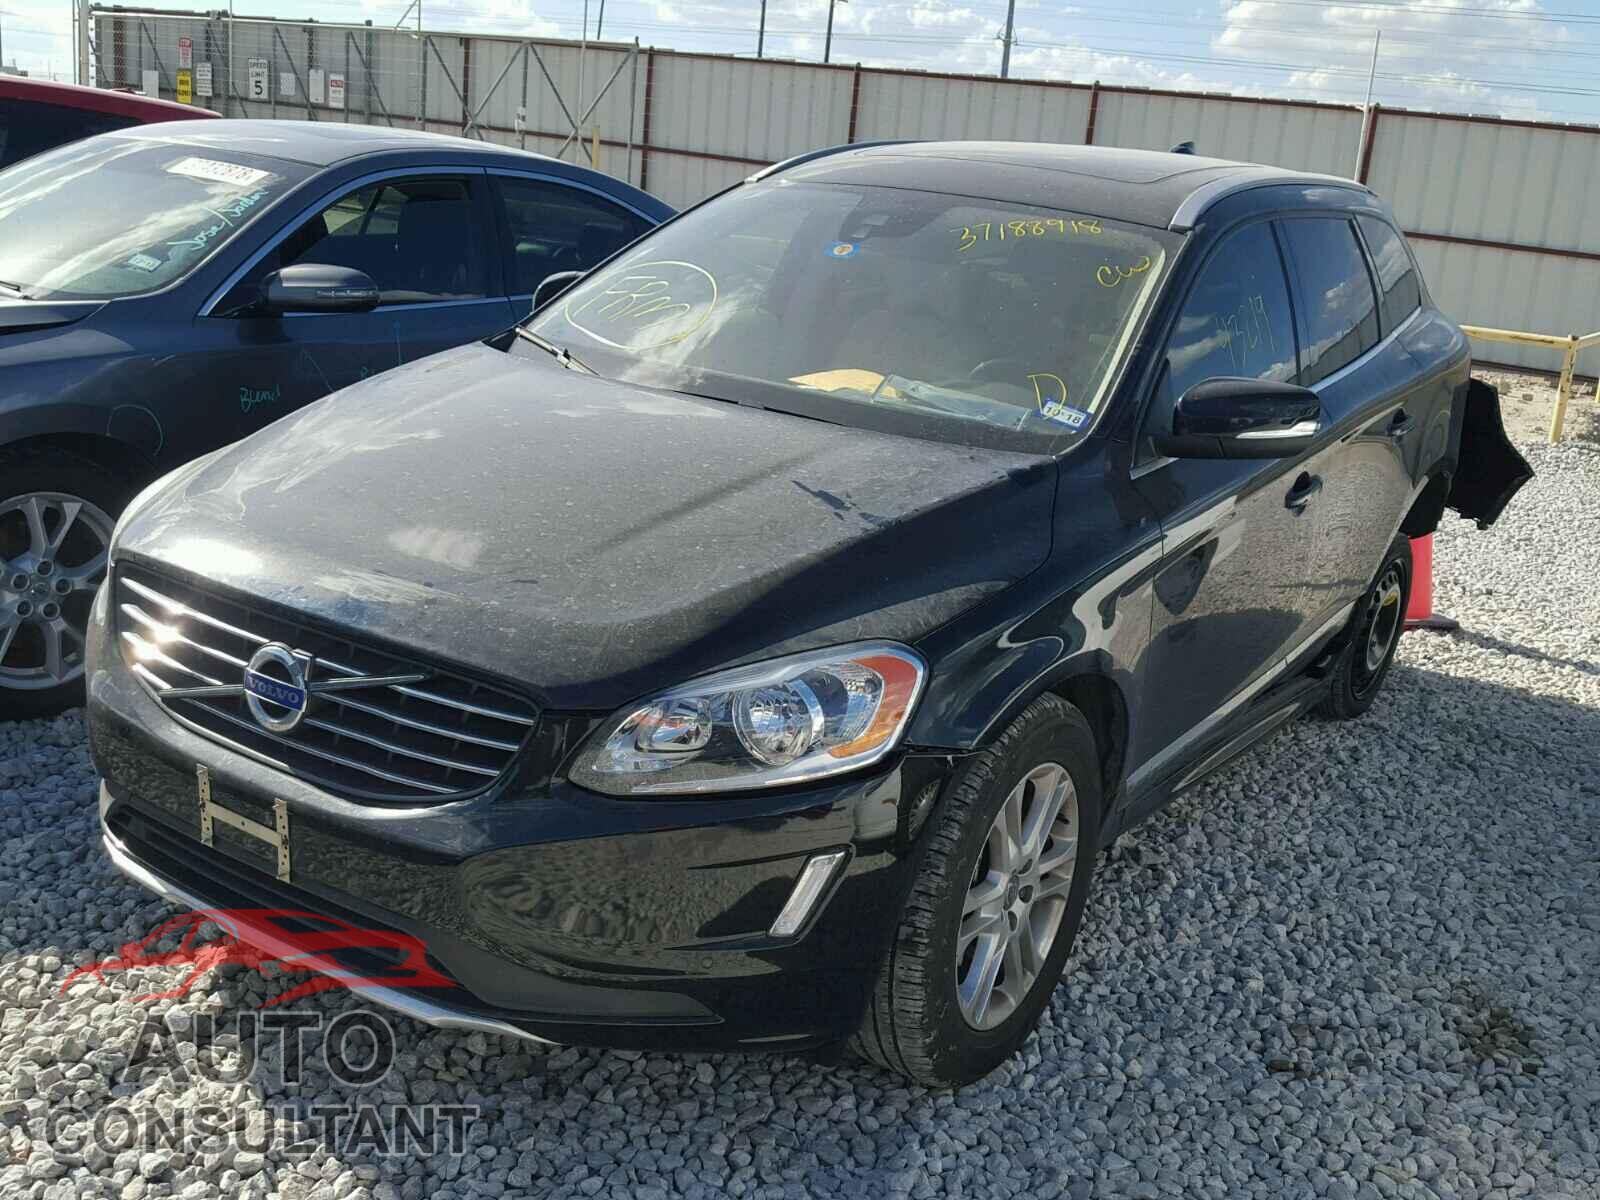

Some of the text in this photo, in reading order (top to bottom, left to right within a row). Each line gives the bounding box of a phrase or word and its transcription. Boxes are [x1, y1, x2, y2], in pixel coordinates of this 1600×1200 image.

[254, 80, 263, 96] 5
[949, 219, 1104, 251] 37188918
[247, 674, 300, 704] VOLVO
